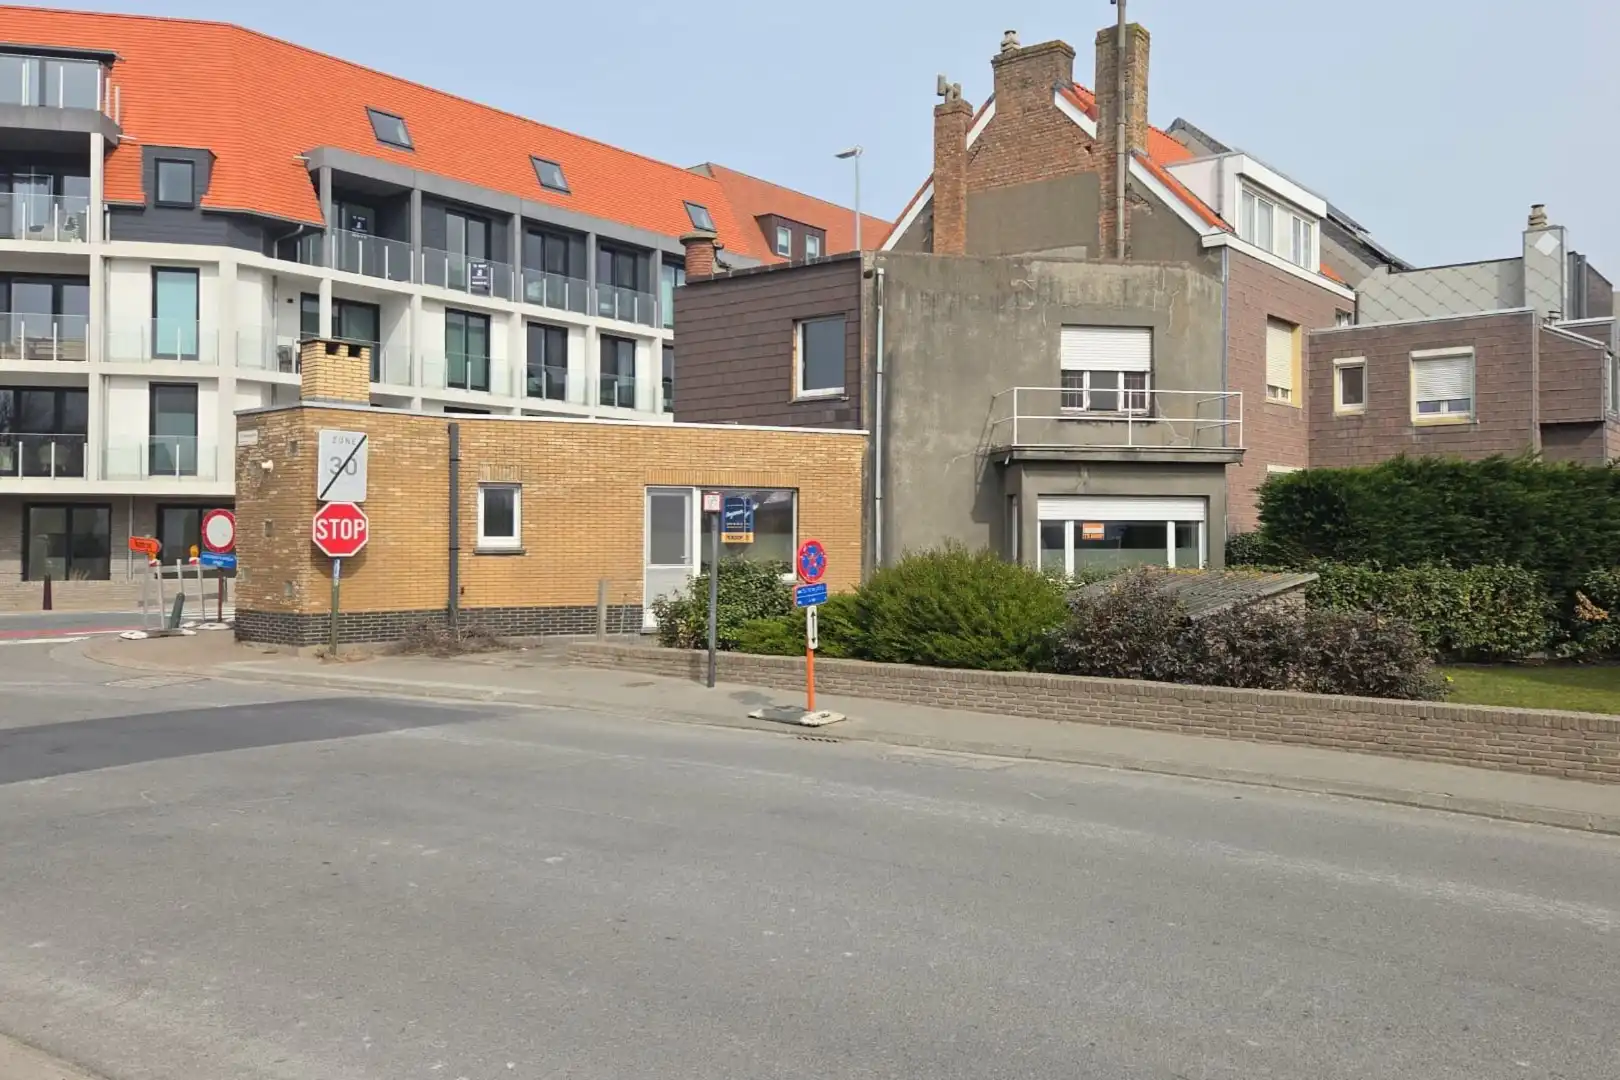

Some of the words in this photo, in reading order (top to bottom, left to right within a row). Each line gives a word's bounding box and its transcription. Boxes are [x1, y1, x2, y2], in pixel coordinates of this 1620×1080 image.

[332, 436, 357, 445] ZONE
[329, 456, 358, 476] 30
[316, 518, 366, 540] STOP
